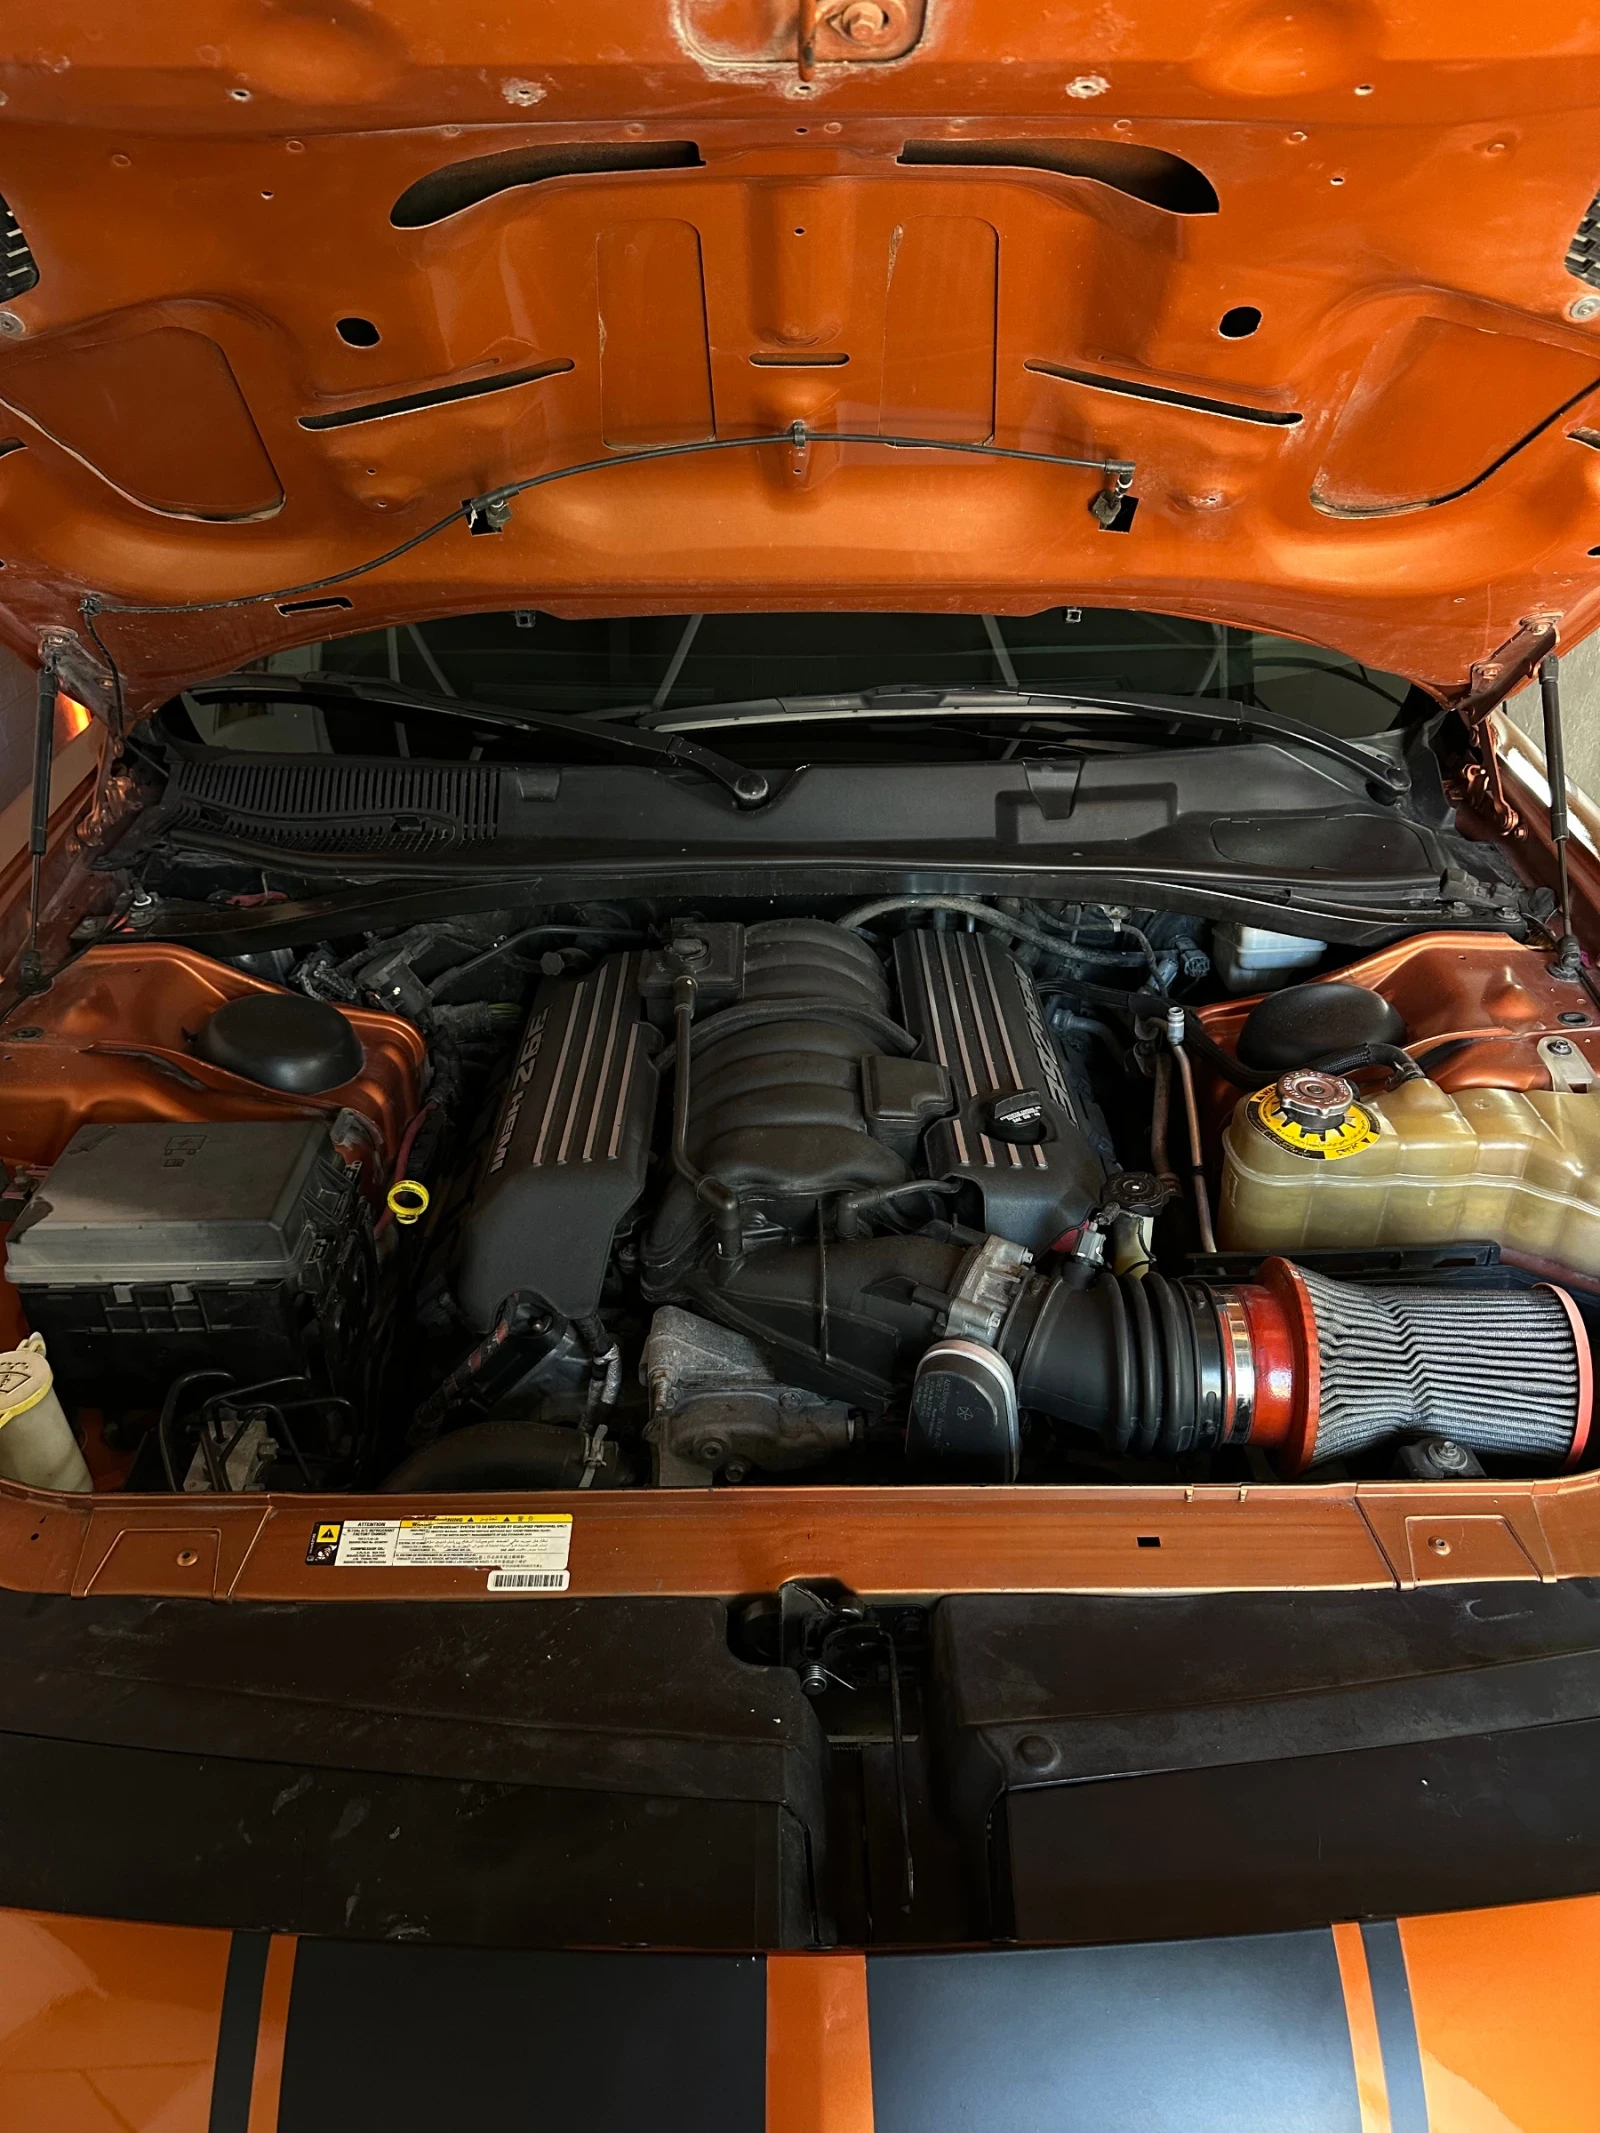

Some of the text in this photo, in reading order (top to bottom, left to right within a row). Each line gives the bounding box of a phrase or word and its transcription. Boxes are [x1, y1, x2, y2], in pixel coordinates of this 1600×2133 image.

[490, 1004, 552, 1174] 392 HEMI
[1028, 1018, 1079, 1127] 392
